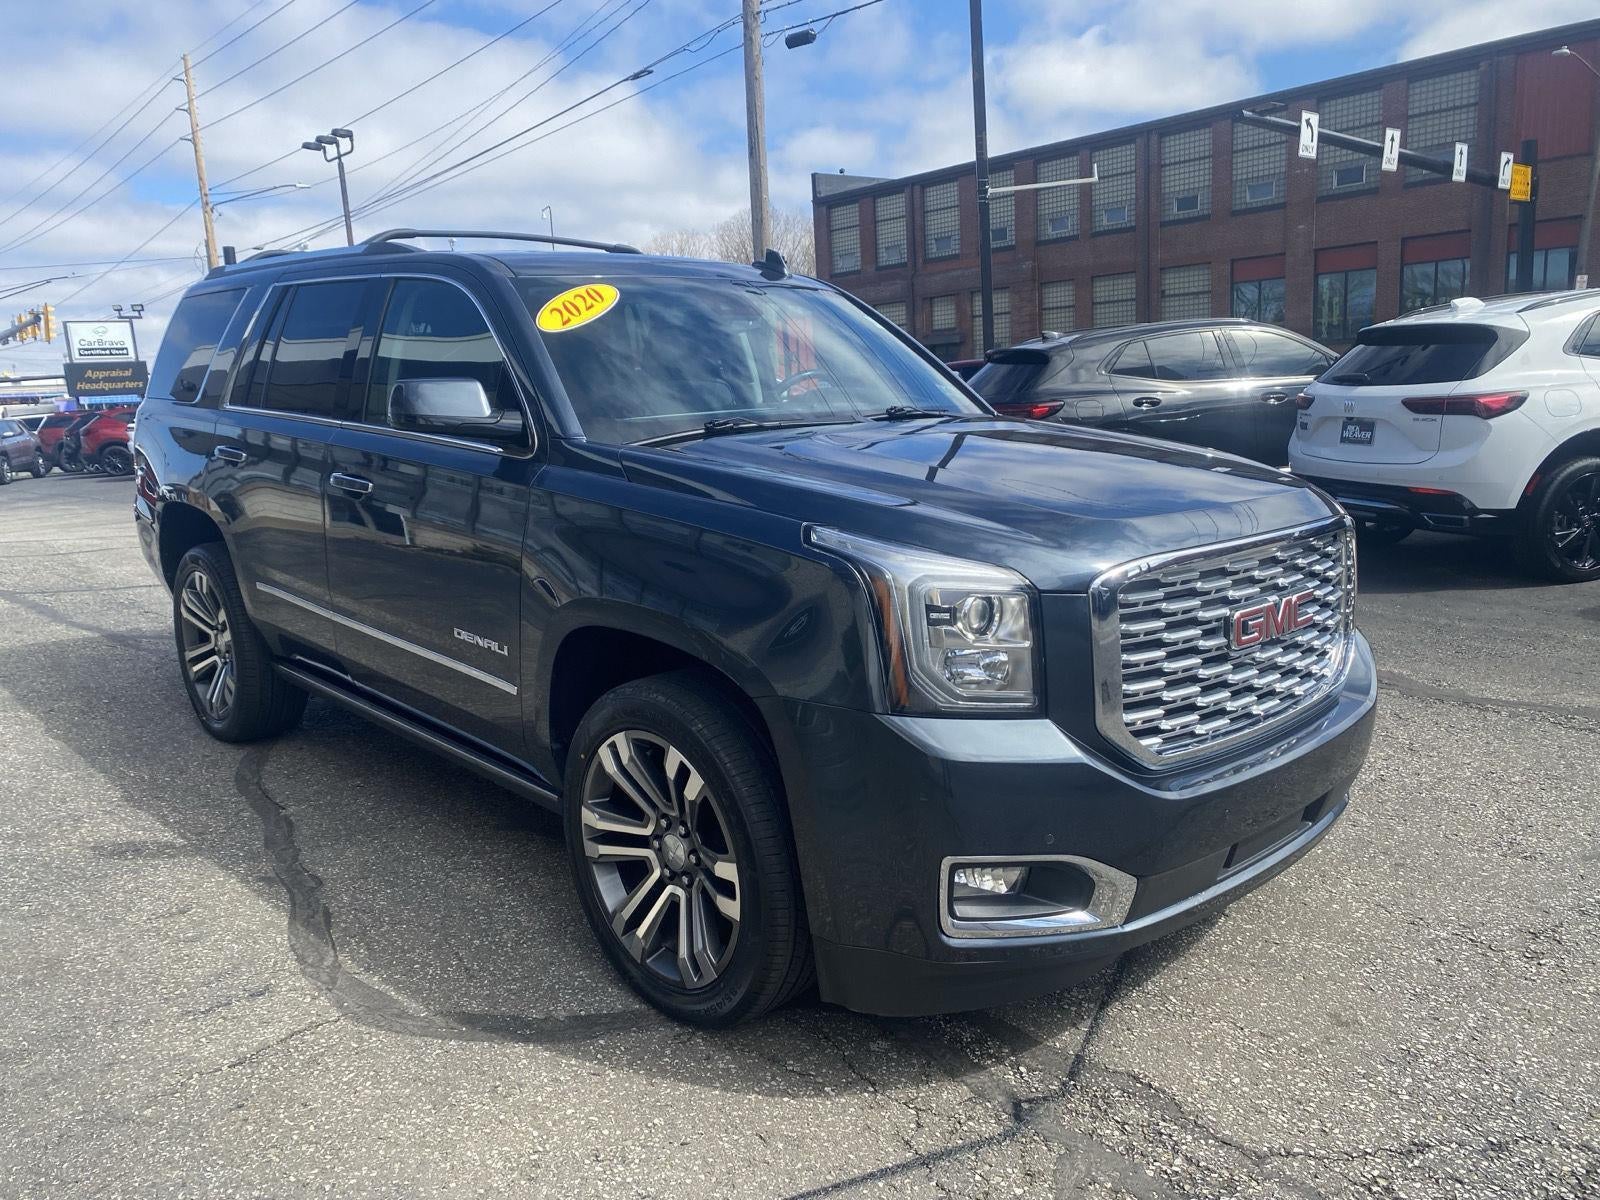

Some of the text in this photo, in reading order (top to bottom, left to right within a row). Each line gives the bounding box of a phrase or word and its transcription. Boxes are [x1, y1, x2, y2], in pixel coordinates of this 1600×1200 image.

[1301, 143, 1315, 154] ONLY
[1385, 156, 1396, 166] ONLY
[1455, 168, 1464, 177] ONLY
[550, 287, 604, 326] 2020
[79, 338, 126, 347] CarBravo
[84, 368, 133, 379] Appraisal
[76, 381, 144, 391] Headquarters
[1343, 430, 1372, 439] WEAVER
[1234, 588, 1314, 649] GMC
[453, 627, 508, 656] DENALI
